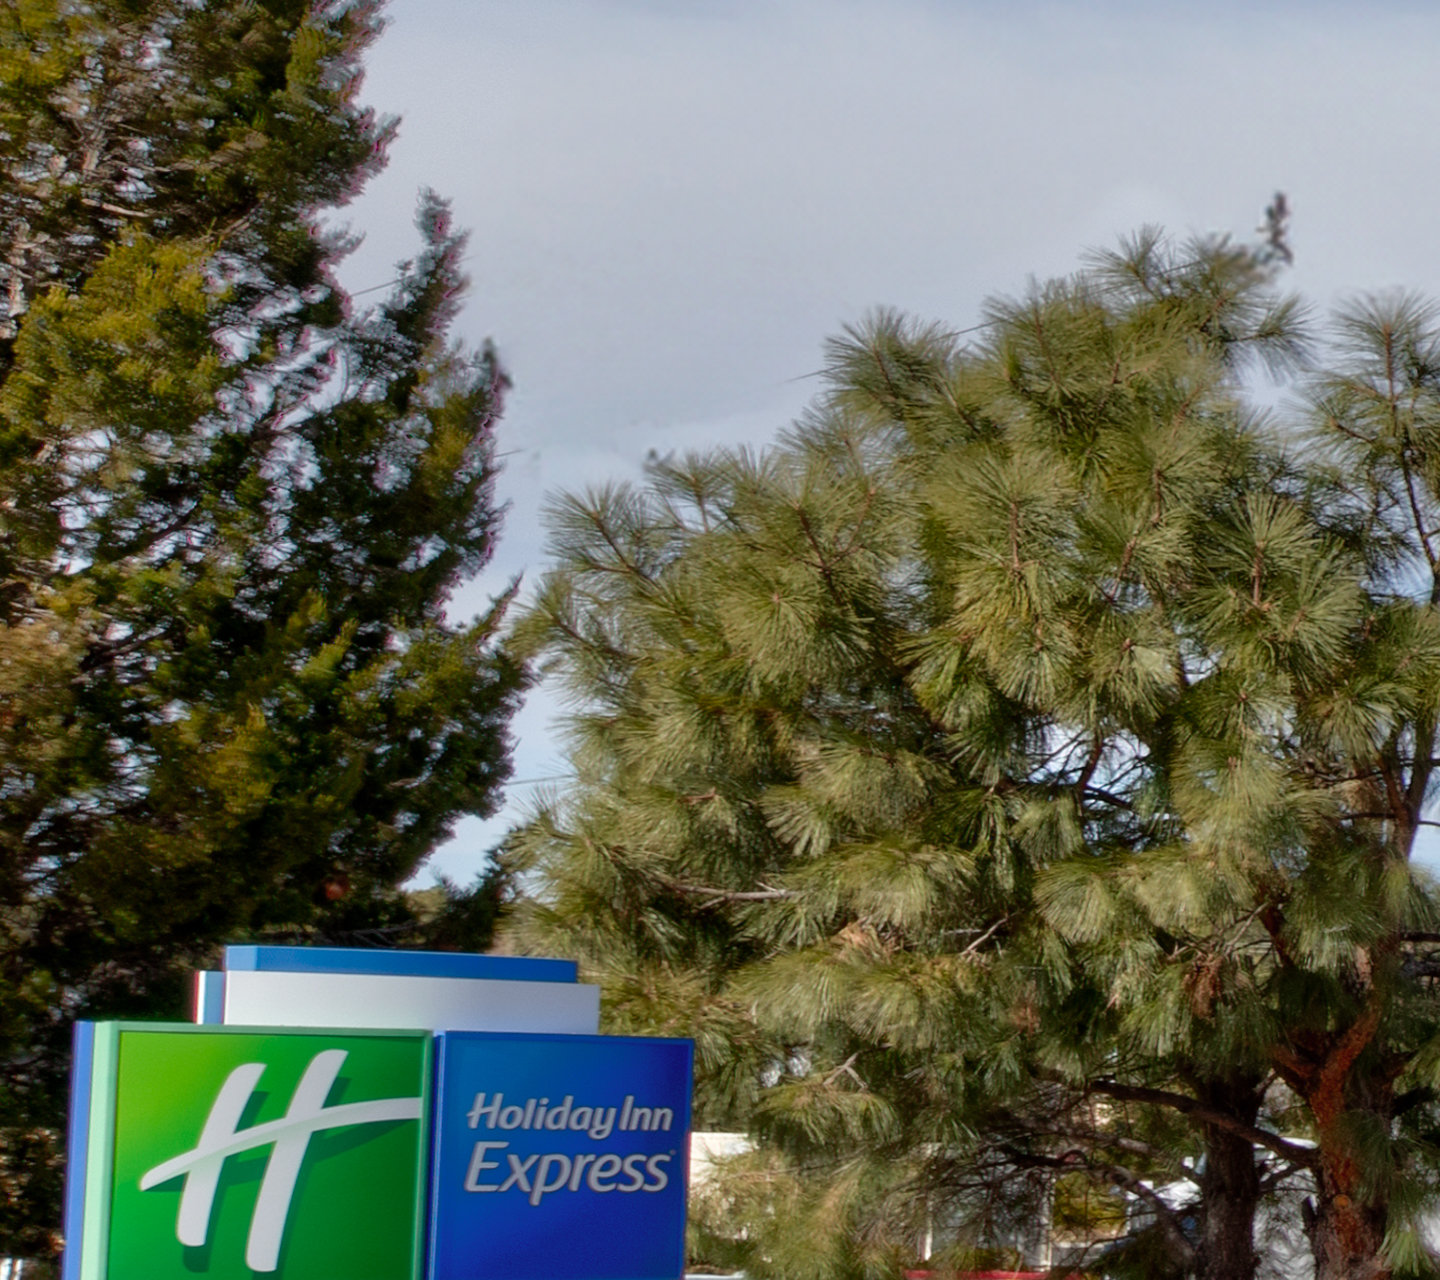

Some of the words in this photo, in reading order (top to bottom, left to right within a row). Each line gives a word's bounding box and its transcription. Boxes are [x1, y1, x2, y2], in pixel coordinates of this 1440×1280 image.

[466, 1092, 617, 1140] Holiday
[618, 1095, 674, 1132] Inn
[463, 1141, 673, 1207] Express
